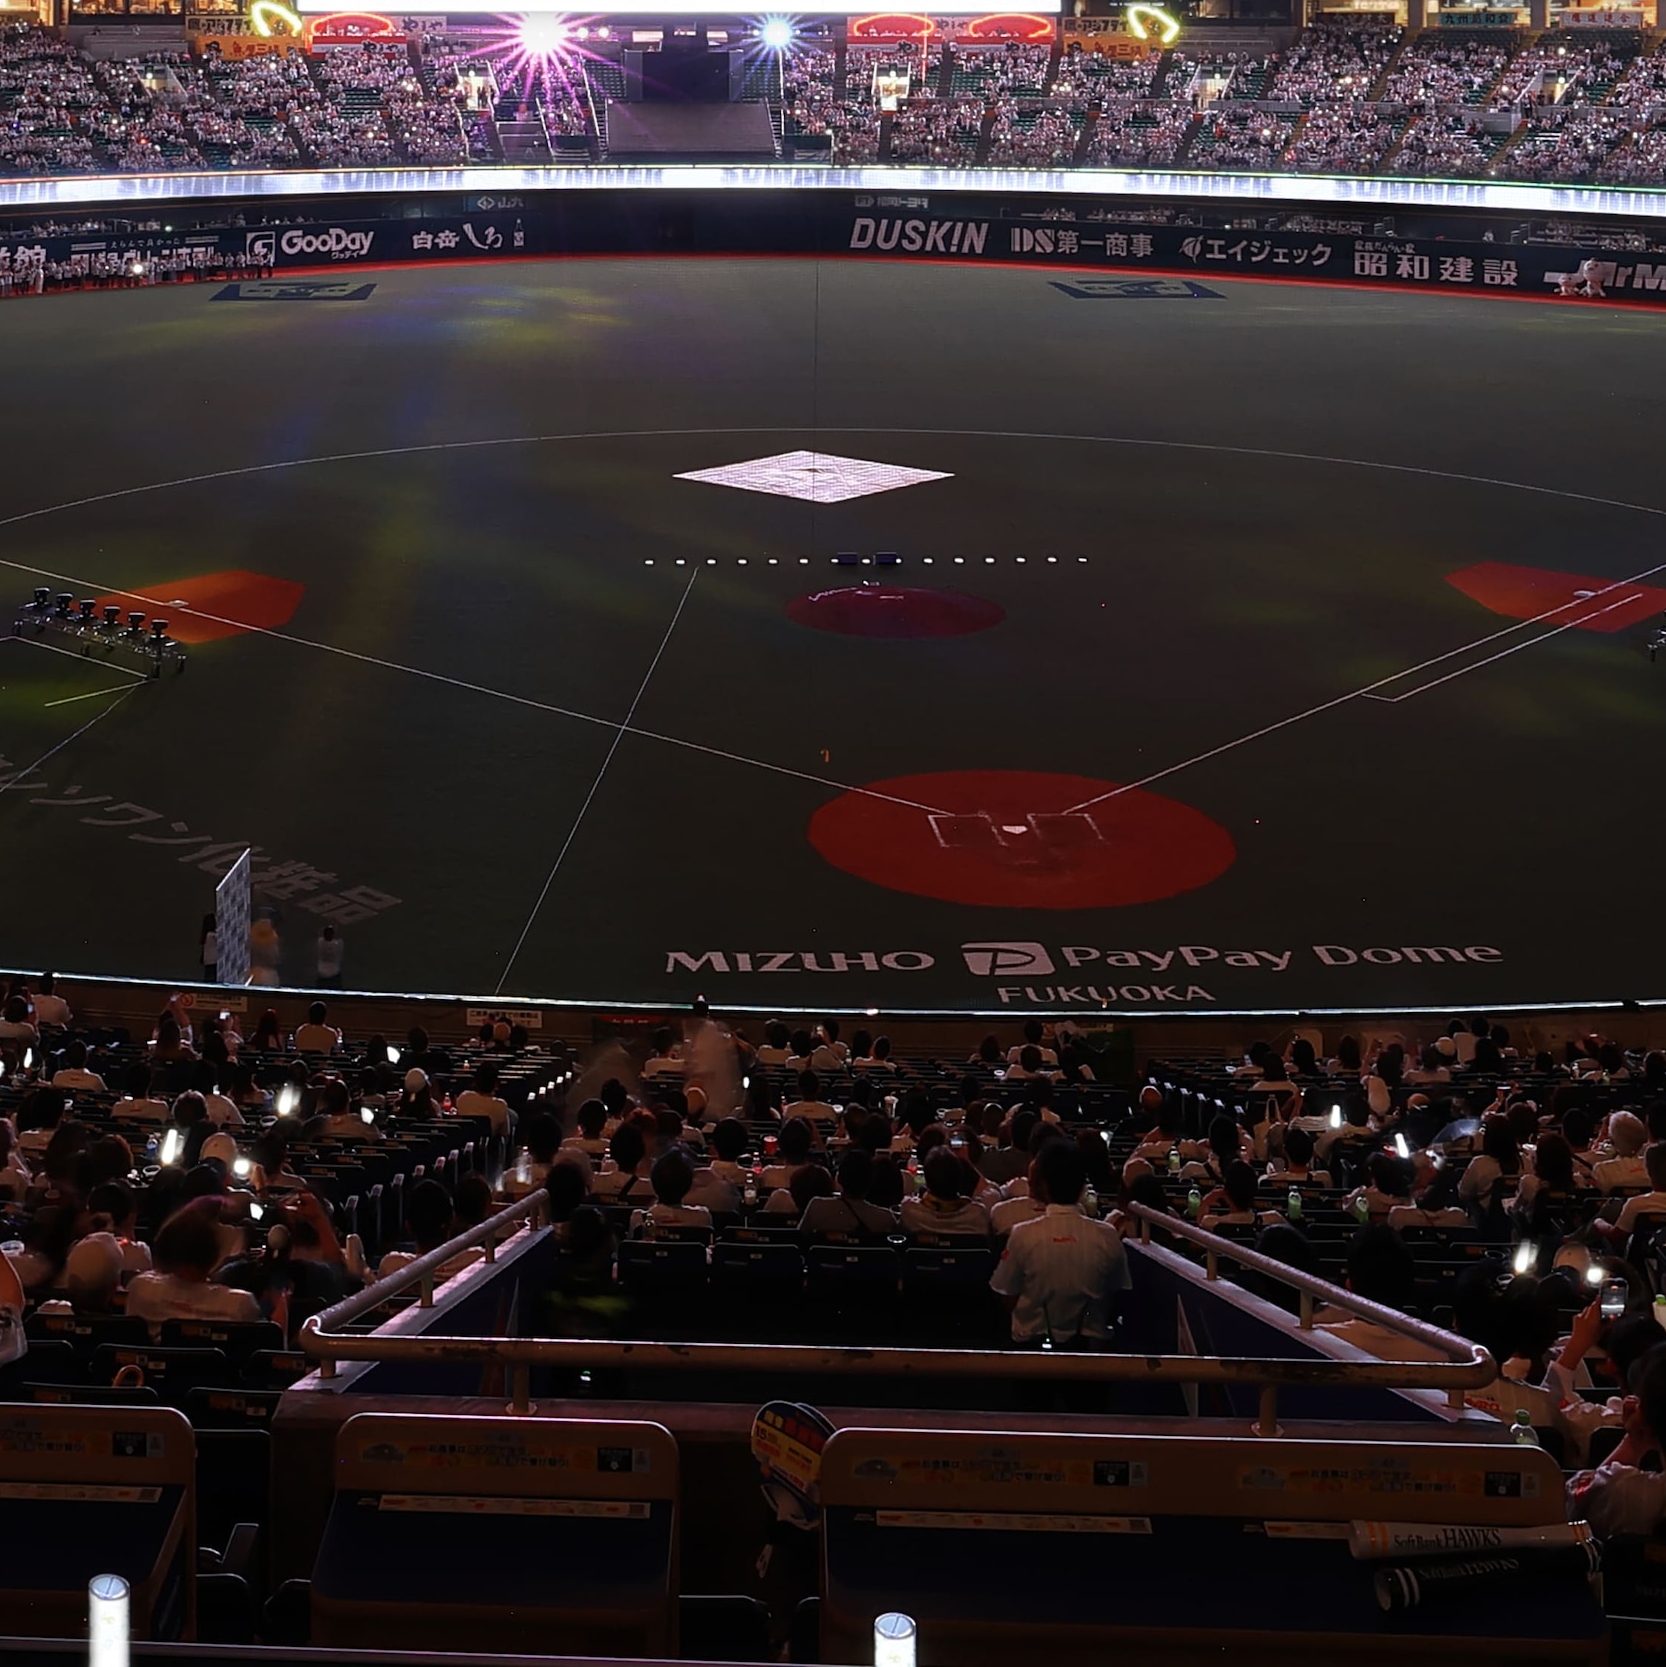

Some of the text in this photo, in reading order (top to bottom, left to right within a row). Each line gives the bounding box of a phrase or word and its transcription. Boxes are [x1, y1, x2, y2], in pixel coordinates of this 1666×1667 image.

[281, 227, 375, 256] GooDay
[1056, 229, 1154, 257] 第一商事
[1206, 235, 1331, 266] エイジェック
[1354, 252, 1518, 287] 昭和建設
[666, 941, 1503, 975] MIZUHO PayPay Dome
[997, 983, 1215, 1006] FUKUOKA
[1442, 1527, 1501, 1548] HAWKS
